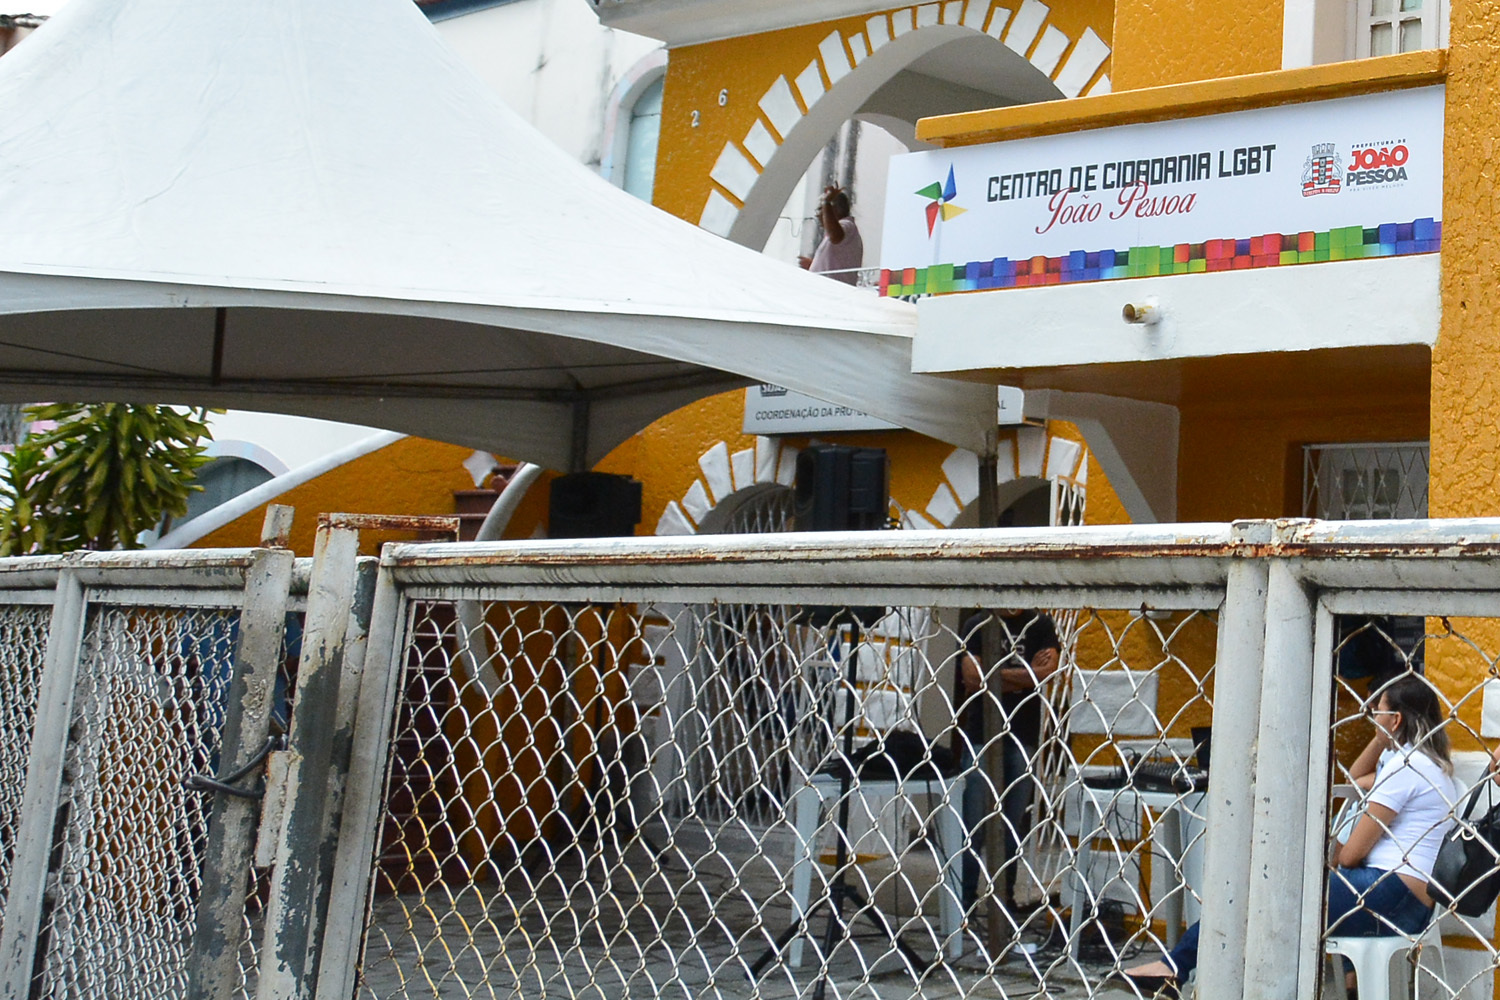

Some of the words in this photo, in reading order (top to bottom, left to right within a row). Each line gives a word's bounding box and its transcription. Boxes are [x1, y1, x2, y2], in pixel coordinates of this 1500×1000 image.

[1351, 139, 1394, 149] PREFEITURA
[1348, 145, 1409, 171] JOÃO
[987, 168, 1062, 202] CENTRO
[1069, 164, 1098, 193] DE
[1102, 152, 1212, 190] CIDADANIA
[1218, 144, 1277, 178] LGBT
[1346, 166, 1408, 187] PESSOA
[1035, 187, 1102, 235] João
[1109, 179, 1198, 220] Pessoa
[755, 406, 819, 421] COORDENAÇÃO
[821, 408, 833, 418] DA
